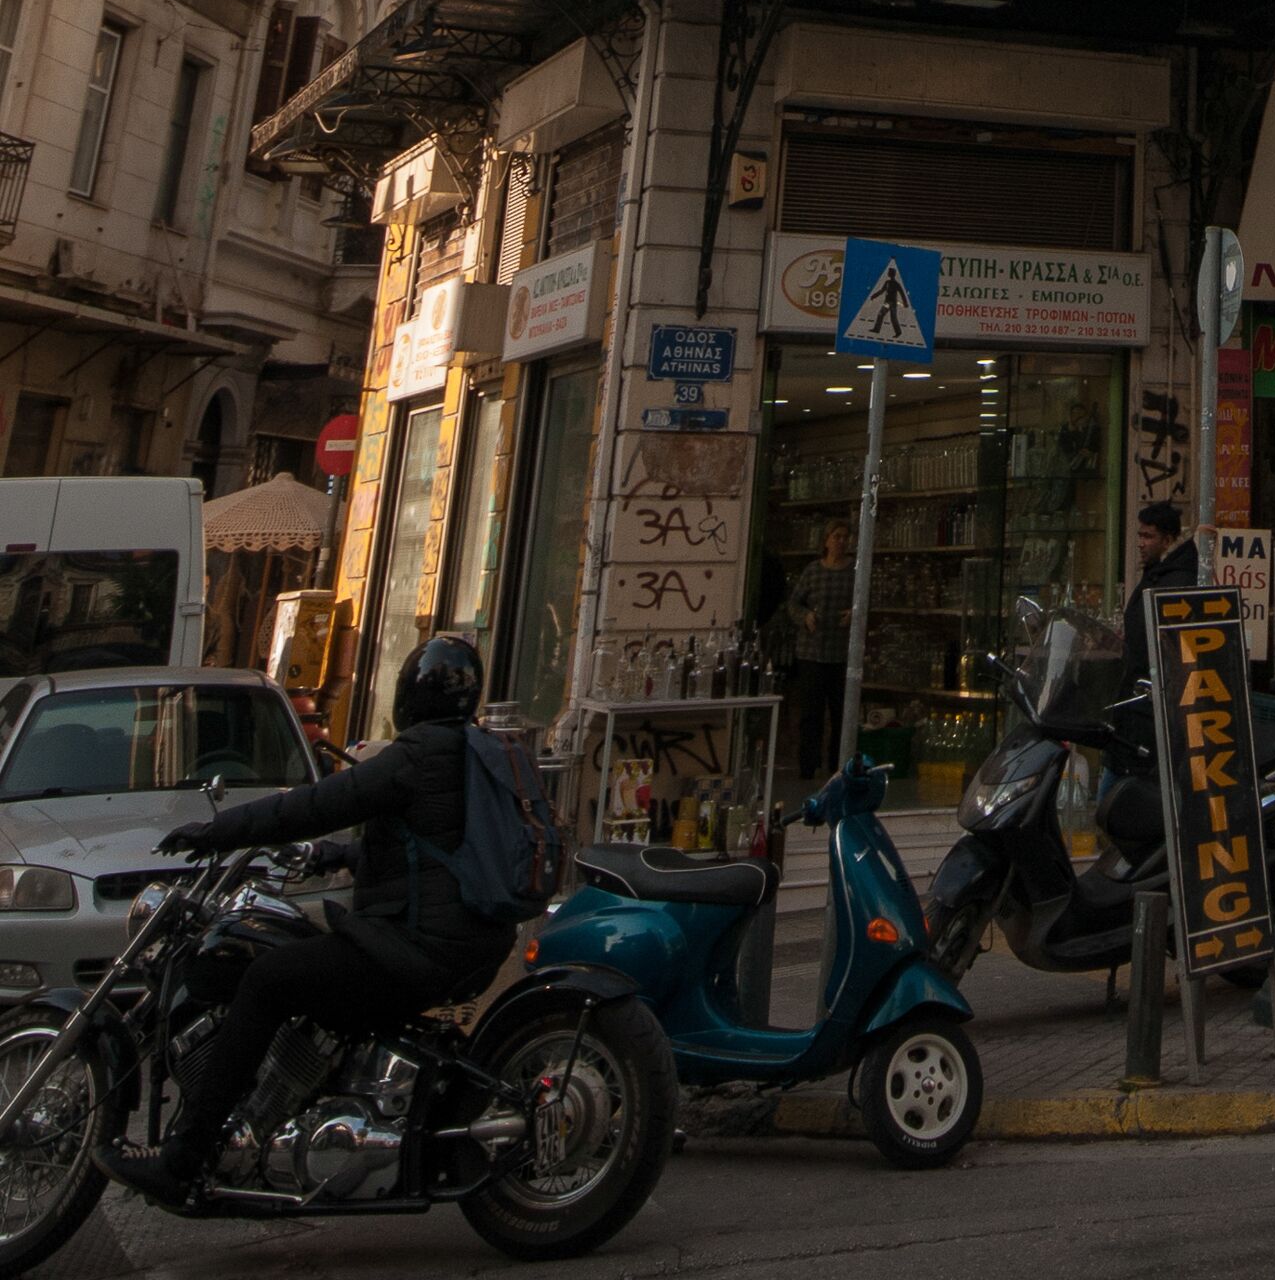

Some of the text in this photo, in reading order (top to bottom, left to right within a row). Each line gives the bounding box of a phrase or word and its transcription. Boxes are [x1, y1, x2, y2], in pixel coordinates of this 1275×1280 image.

[1010, 260, 1078, 283] ΚΡΑΣΣΑ
[1083, 269, 1092, 284] &
[804, 290, 841, 309] 196
[938, 285, 1009, 300] ΣΑΓΩΓΕΣ
[1032, 290, 1104, 305] ΕΜΠΟΡΙΟ
[937, 303, 1019, 319] ΠΟΘΗΚΕΥΣΗΣ
[675, 331, 717, 344] ΟΔΟΣ
[662, 346, 723, 360] ΑΘΗΝΑΣ
[661, 361, 721, 374] ATHINAS
[679, 386, 699, 401] 39
[1180, 628, 1252, 922] PARKING
